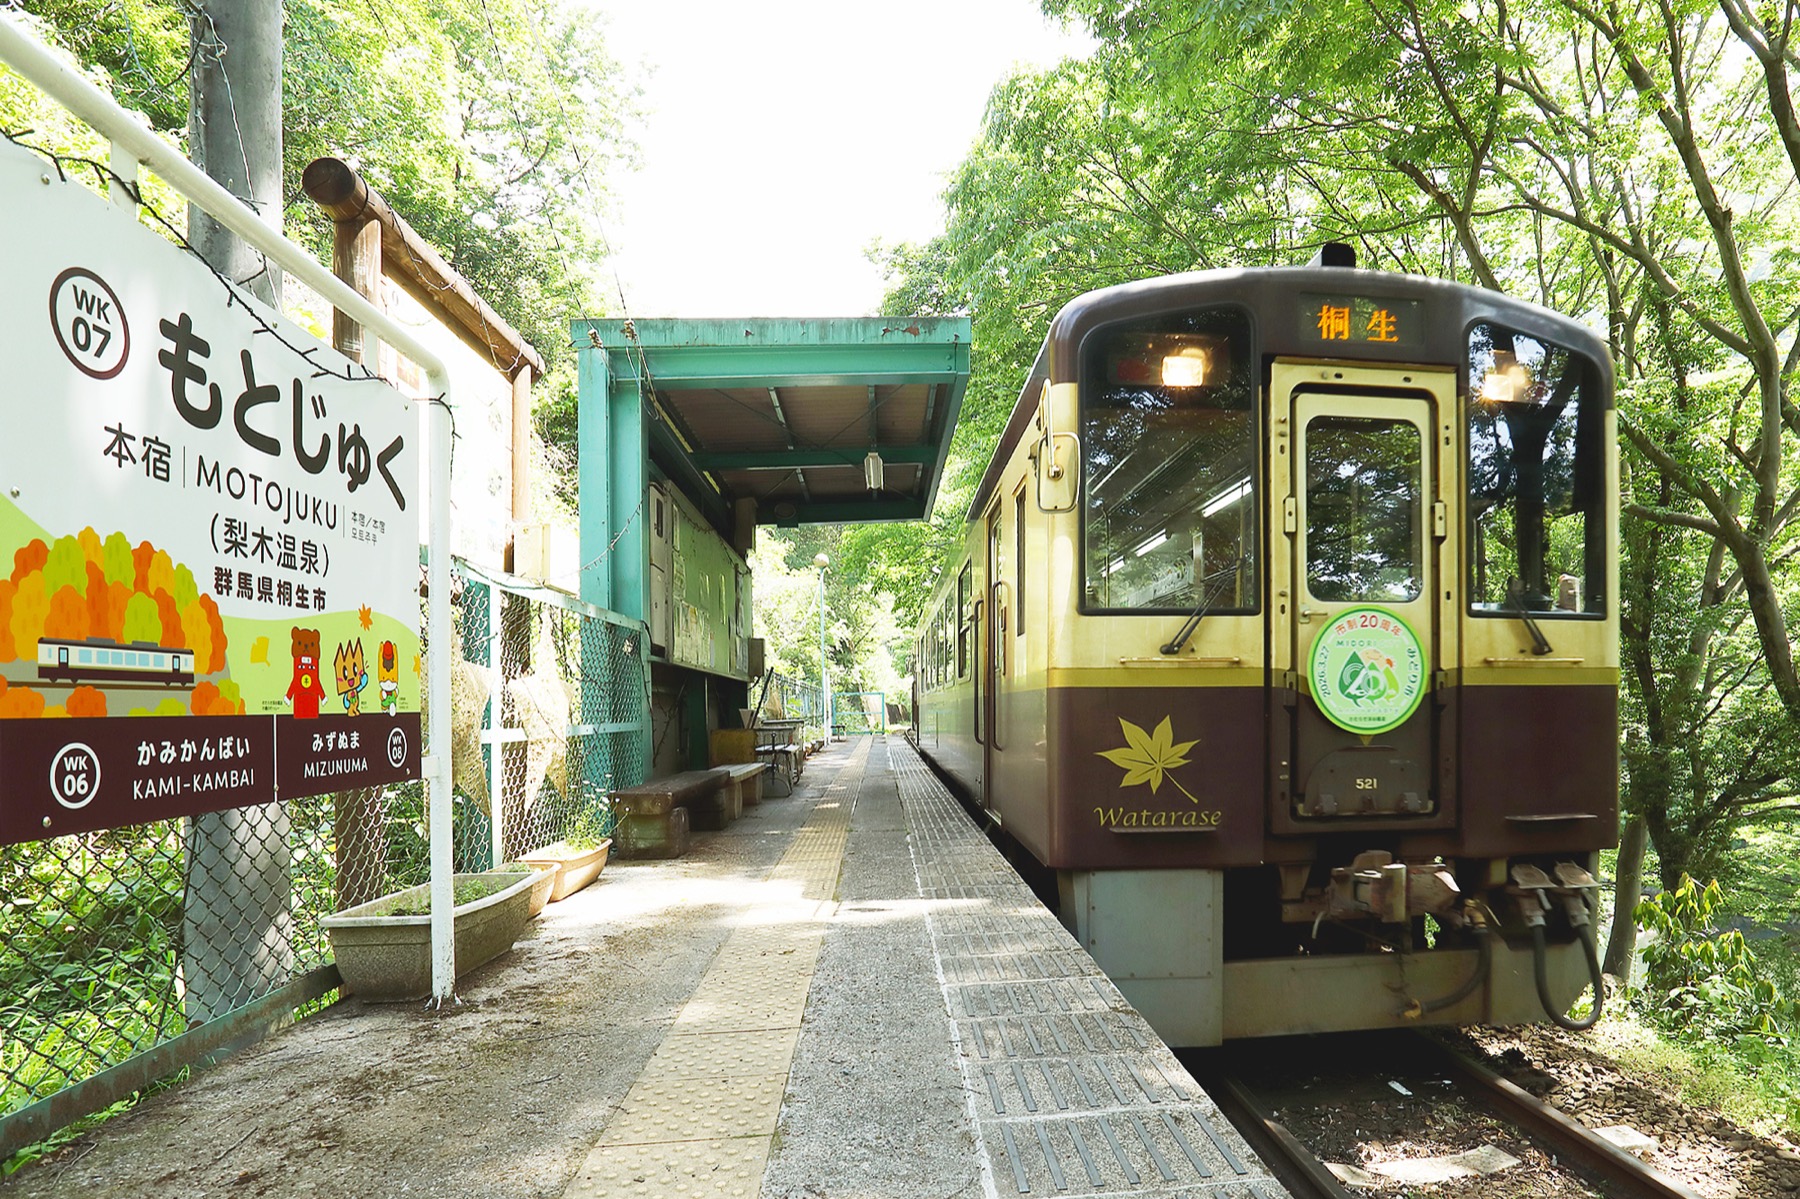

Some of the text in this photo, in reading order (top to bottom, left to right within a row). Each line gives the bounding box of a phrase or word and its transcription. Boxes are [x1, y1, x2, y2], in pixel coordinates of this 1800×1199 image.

[72, 284, 111, 325] WK
[72, 316, 112, 359] 07
[1317, 305, 1399, 342] 桐生
[158, 312, 407, 512] もとじゅく
[103, 422, 336, 530] 本宿 MOTOJUKU
[211, 512, 329, 578] (梨木温泉)
[213, 565, 327, 612] 群馬県桐生市
[136, 735, 251, 767] かみかんばい
[312, 730, 360, 753] みずぬま
[392, 735, 403, 746] WK
[392, 747, 403, 760] 08
[63, 756, 89, 771] WK
[304, 757, 368, 779] MIZUNUMA
[63, 773, 90, 797] 06
[132, 768, 255, 801] KAMI-KAMBAI
[1355, 778, 1377, 790] 521
[1093, 807, 1222, 827] Watarase
